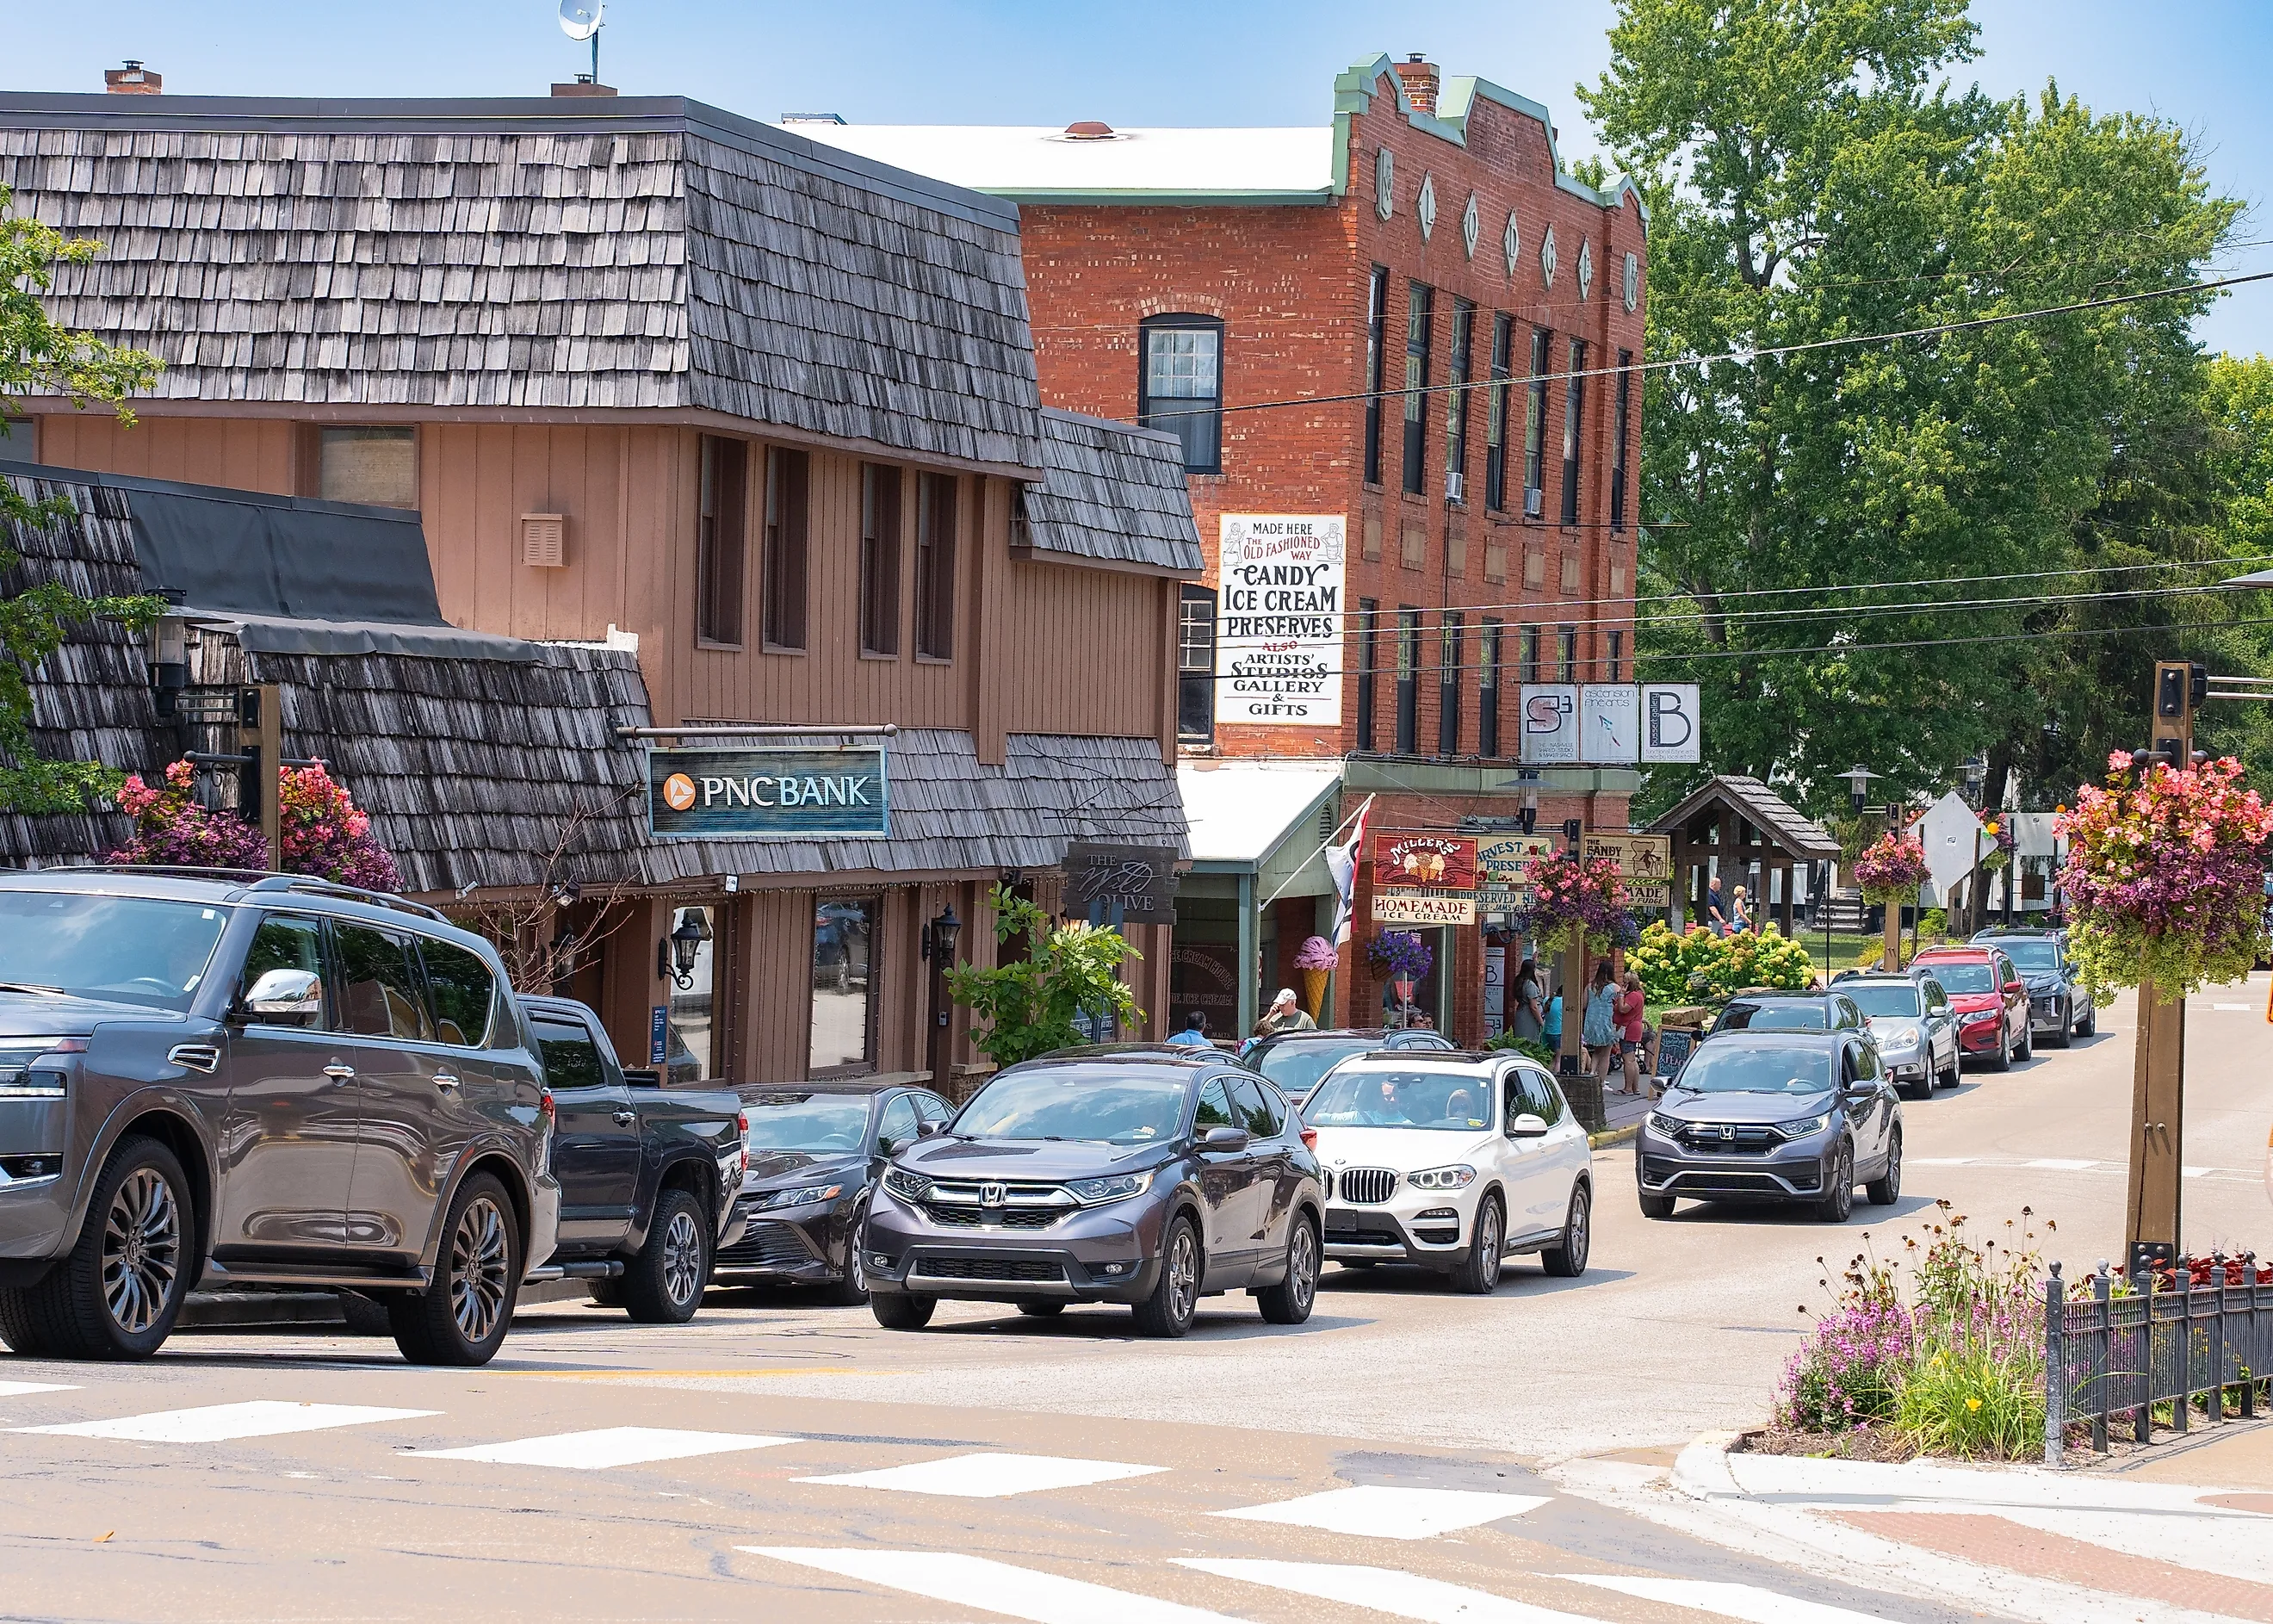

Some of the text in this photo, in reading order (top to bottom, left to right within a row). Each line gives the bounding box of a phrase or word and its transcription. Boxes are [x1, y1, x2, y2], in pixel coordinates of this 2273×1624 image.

[1253, 523, 1313, 535] MADE HERE
[1243, 536, 1321, 560] OLD FASHIONED
[1291, 551, 1312, 561] WAY
[1233, 563, 1329, 586] CANDY
[1224, 585, 1338, 612] ICE CREAM
[1227, 617, 1333, 638] PRESERVES
[1261, 641, 1298, 652] ALSO
[1245, 654, 1315, 665] ARTISTS'
[1231, 661, 1328, 679] STUDIOS
[1233, 679, 1324, 692] GALLERY
[1273, 693, 1285, 702] &
[1584, 698, 1630, 707] fine arts
[1248, 704, 1308, 716] GIFTS
[699, 776, 870, 807] PNC BANK
[1477, 841, 1523, 862] ARVEST
[1087, 854, 1118, 866] THE
[1078, 861, 1163, 902] Wild
[1460, 891, 1515, 903] PRESERVED
[1374, 898, 1469, 914] HOMEMADE
[1415, 913, 1461, 921] CREAM
[1181, 950, 1212, 970] CREAM
[1209, 960, 1236, 990] HOUSE
[1200, 994, 1233, 1006] CREAM
